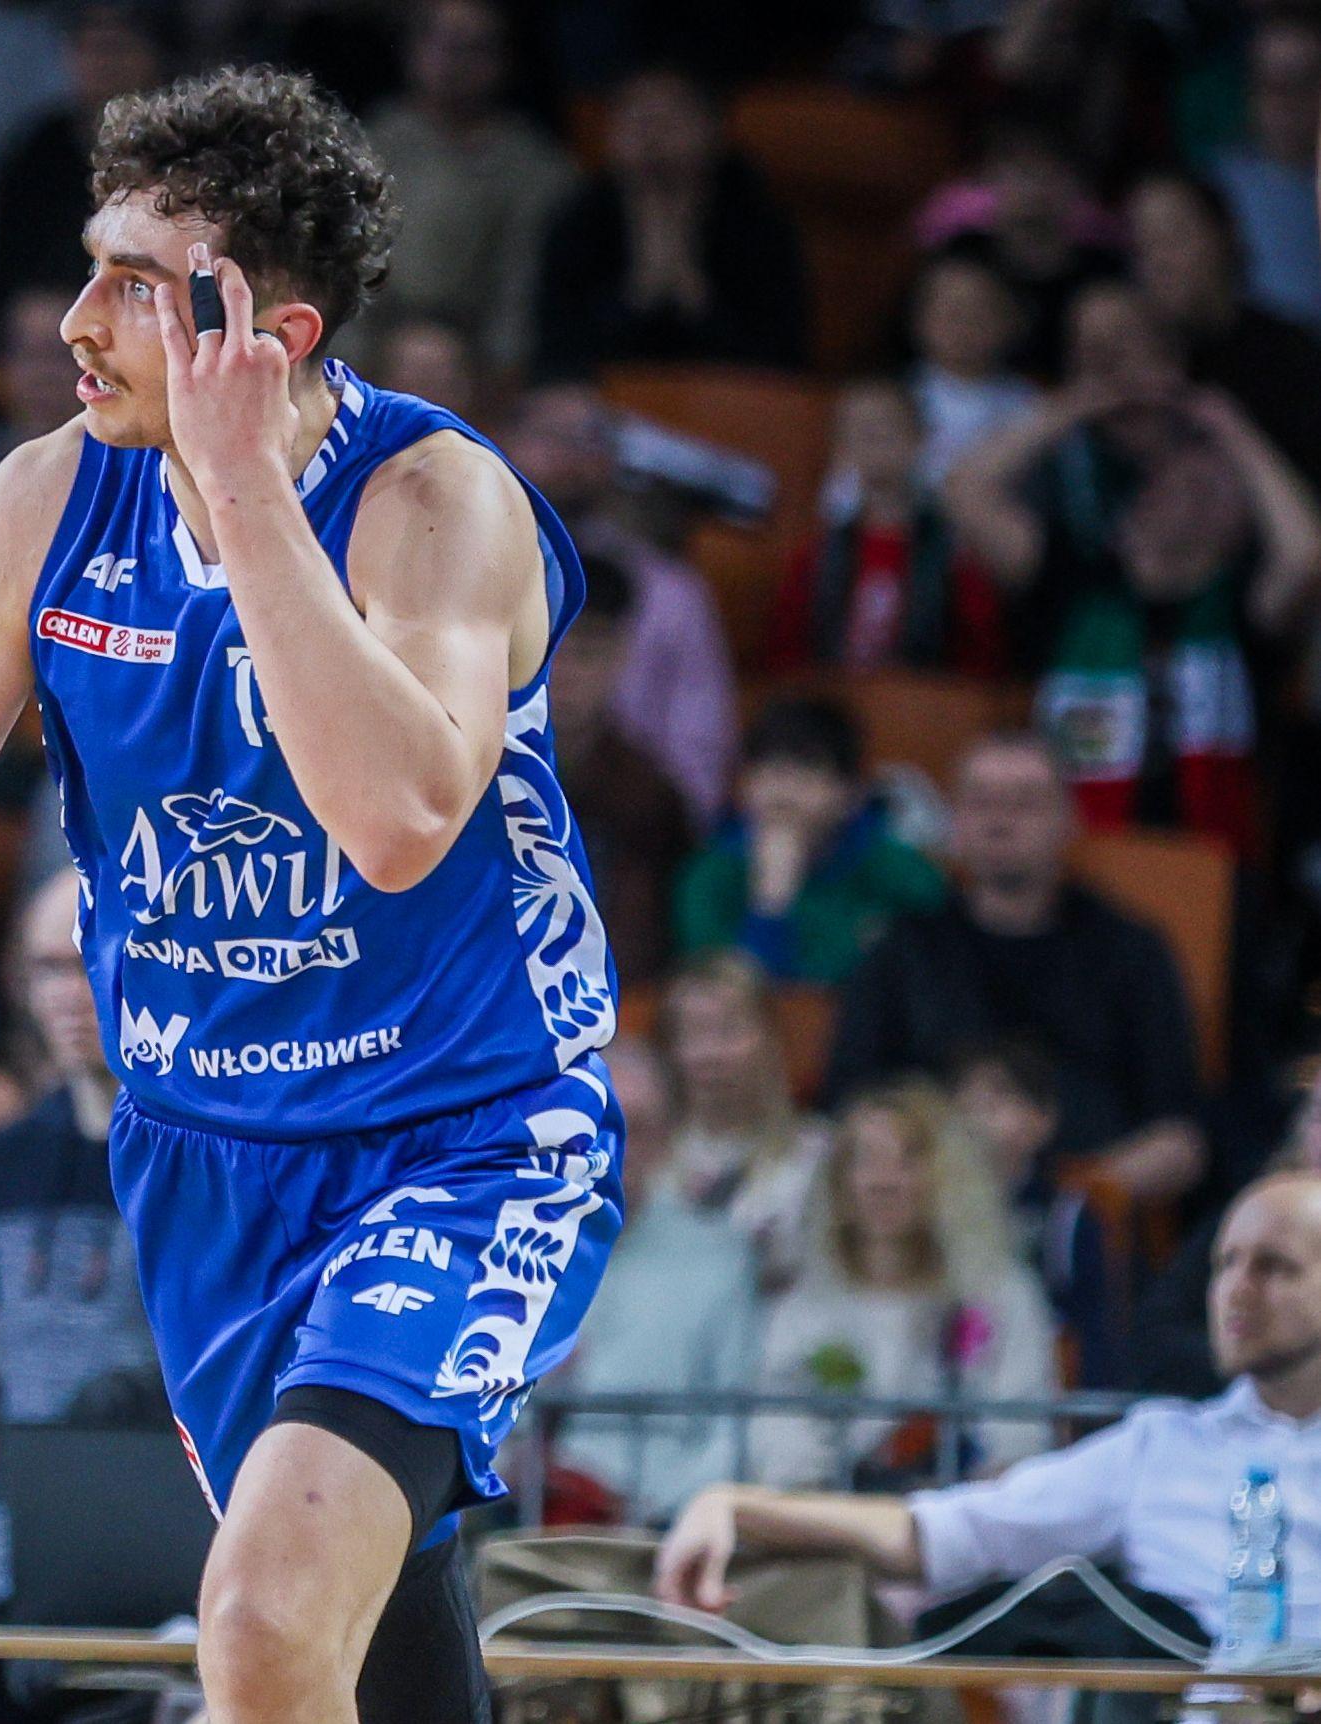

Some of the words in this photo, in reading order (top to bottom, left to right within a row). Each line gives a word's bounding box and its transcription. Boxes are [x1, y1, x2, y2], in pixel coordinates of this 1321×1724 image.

[83, 553, 137, 592] 4F
[45, 616, 103, 646] ORLEN
[136, 634, 173, 646] Baske
[135, 647, 161, 660] Liga
[120, 807, 345, 925] Anwil
[125, 930, 214, 973] RUPA
[226, 935, 351, 977] ORLEN
[190, 1026, 402, 1078] WŁOCŁAWEK
[352, 1282, 436, 1315] 4F
